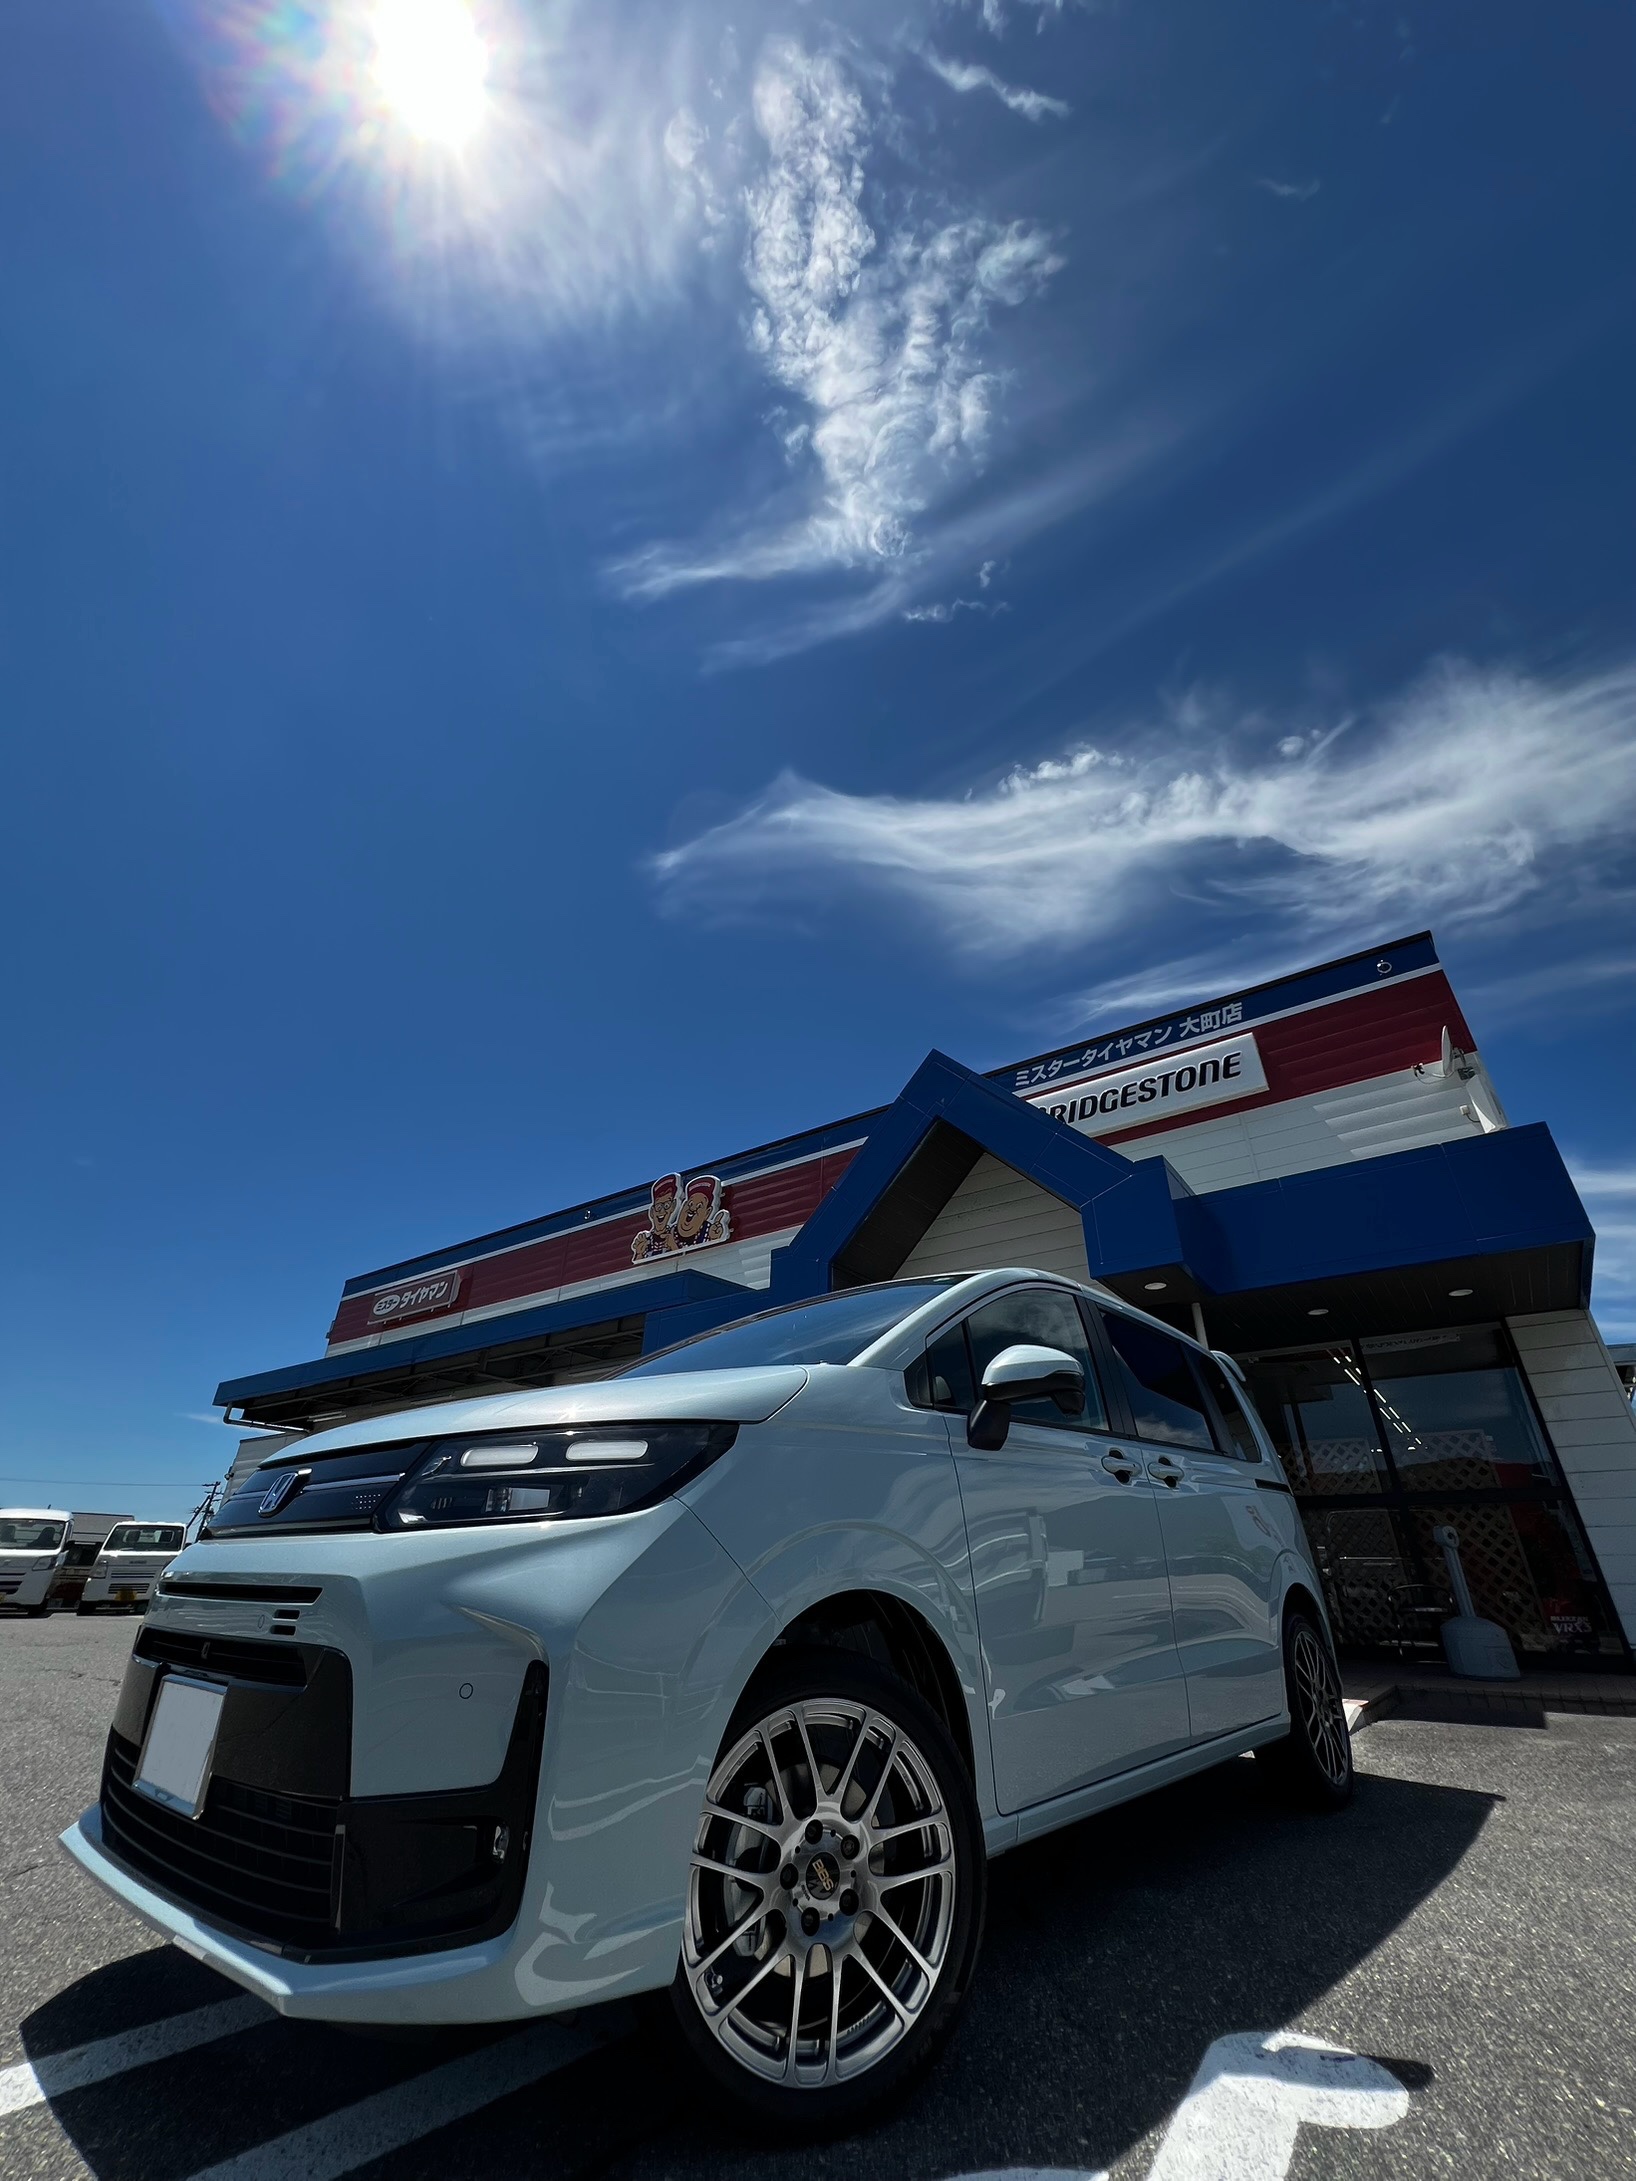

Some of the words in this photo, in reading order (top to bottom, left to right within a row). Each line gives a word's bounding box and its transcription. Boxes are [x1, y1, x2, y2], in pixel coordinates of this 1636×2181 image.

[1015, 1025, 1172, 1087] ミスタータイヤマン
[1179, 1001, 1243, 1038] 大町店
[399, 1280, 449, 1309] タイヤマン
[812, 1858, 834, 1891] BBS
